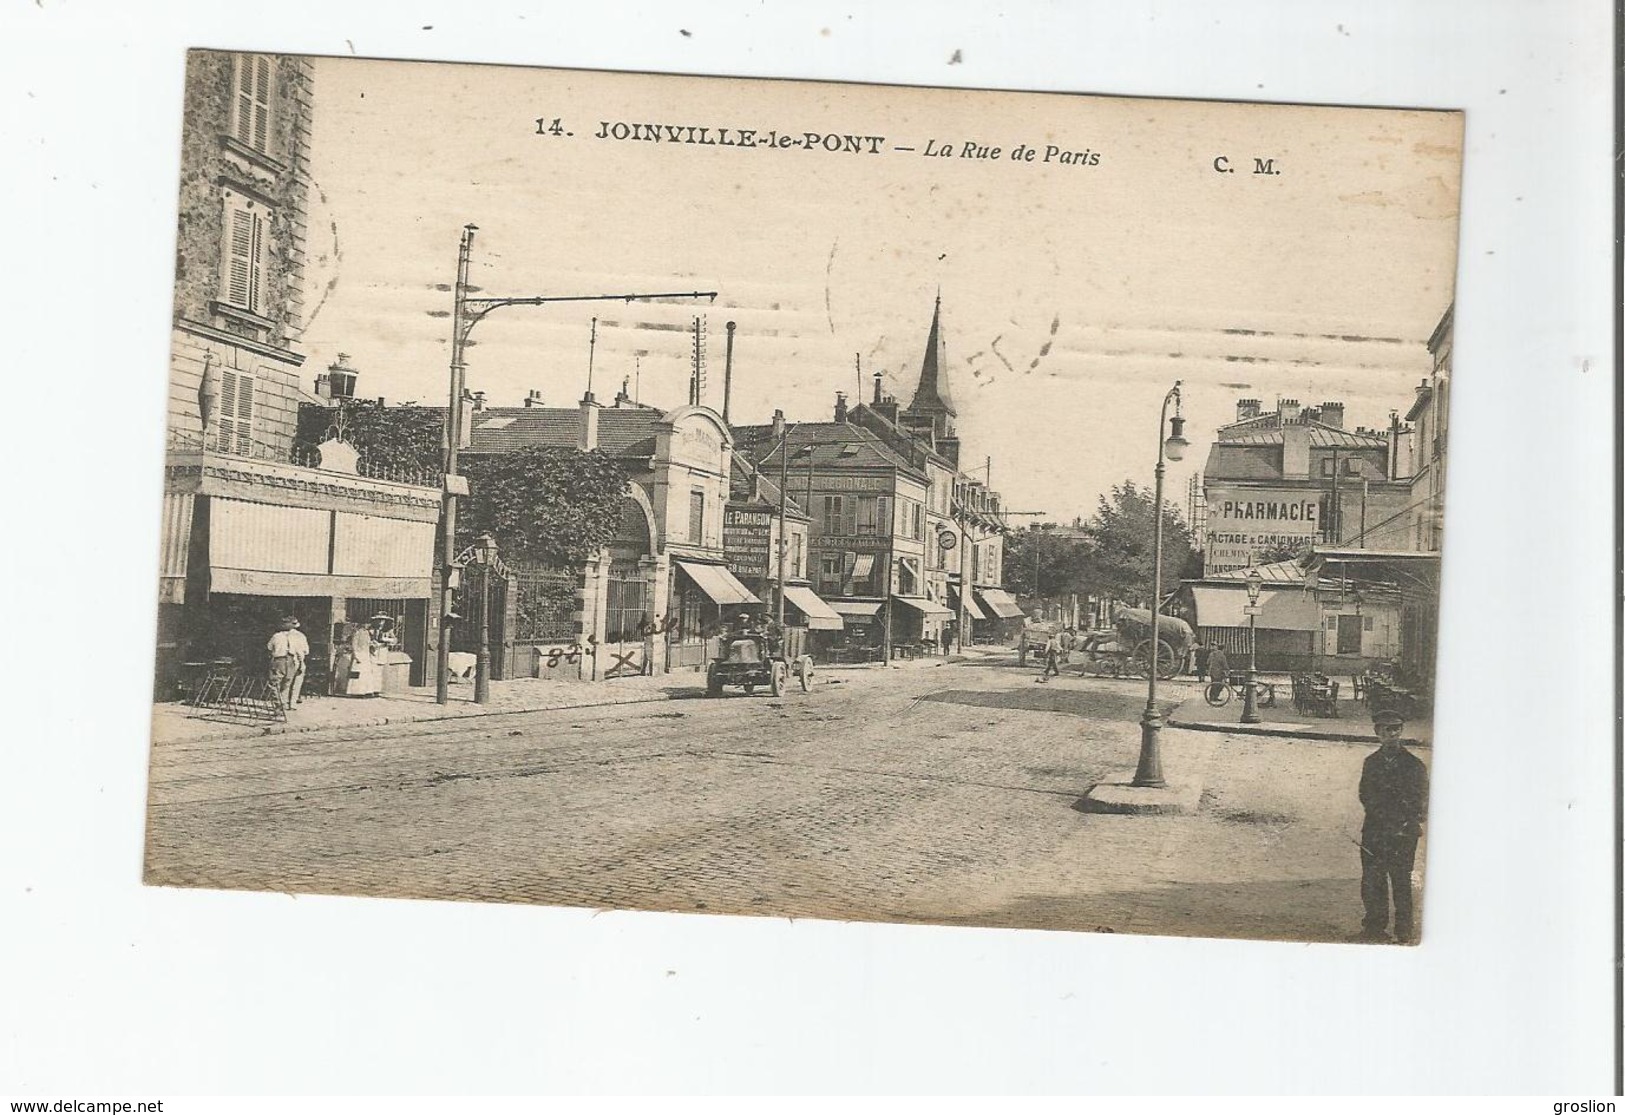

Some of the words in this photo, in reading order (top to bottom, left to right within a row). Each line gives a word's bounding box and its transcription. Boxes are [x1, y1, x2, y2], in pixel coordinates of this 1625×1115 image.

[535, 118, 574, 136] 14.
[595, 121, 885, 154] JOINVILLE-le-PONT
[924, 140, 952, 158] La
[960, 141, 1001, 160] Rue
[1011, 144, 1036, 162] de
[1043, 145, 1100, 166] Paris
[1214, 156, 1235, 174] C.
[1253, 158, 1281, 175] M.
[725, 512, 733, 524] LE
[1223, 500, 1316, 521] PHARMACIE
[1207, 533, 1247, 544] FACTAGE
